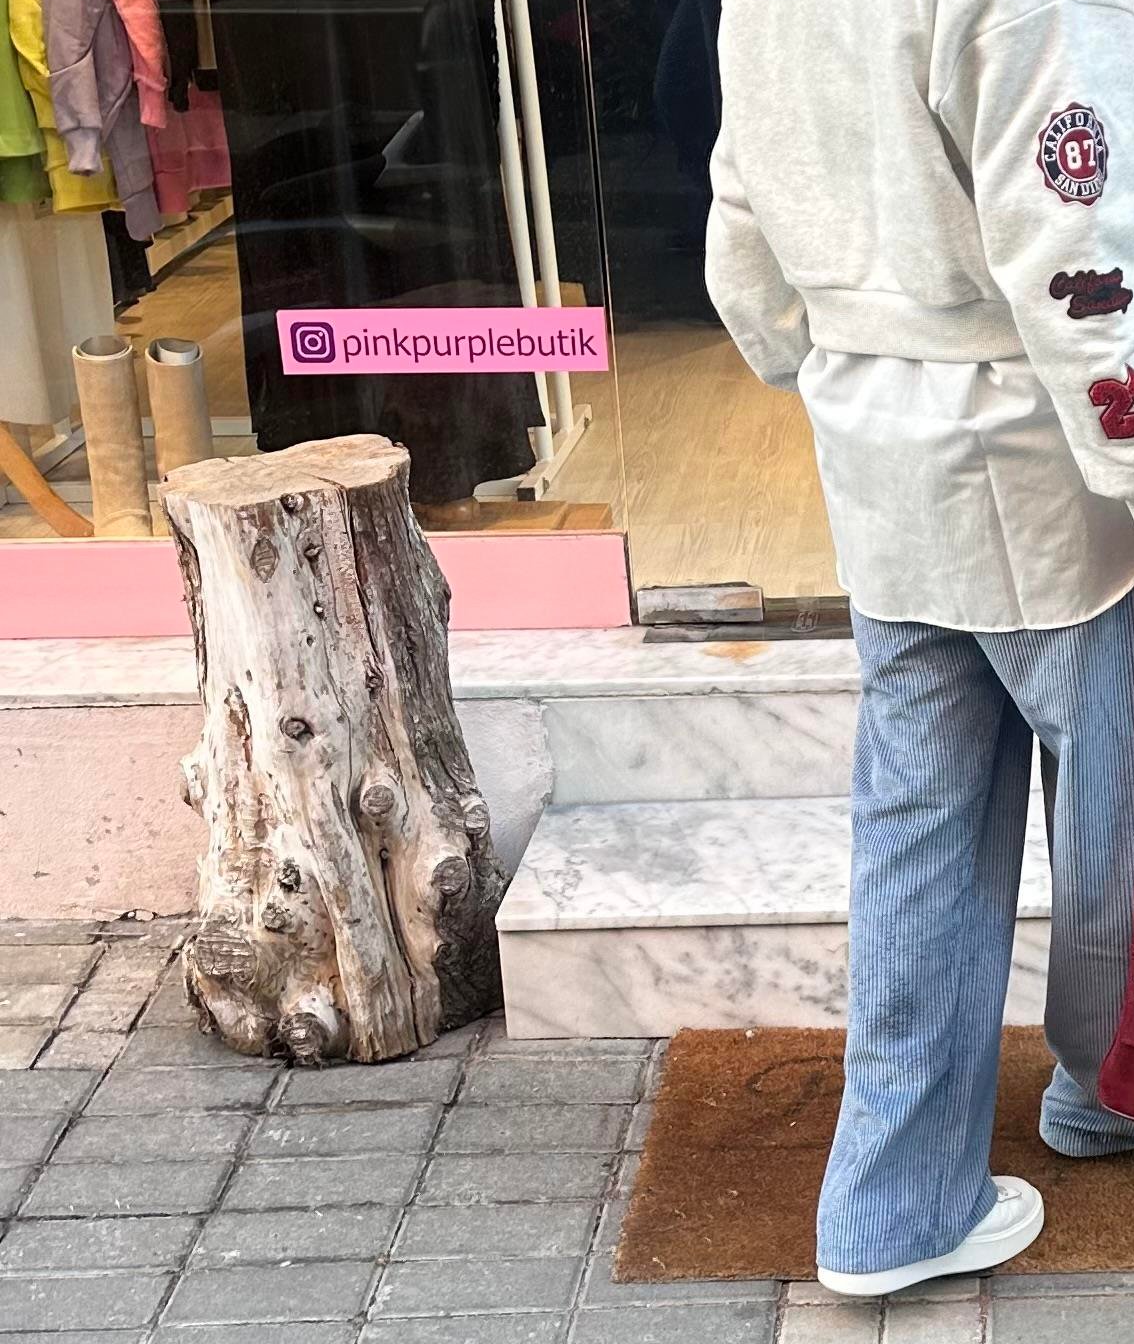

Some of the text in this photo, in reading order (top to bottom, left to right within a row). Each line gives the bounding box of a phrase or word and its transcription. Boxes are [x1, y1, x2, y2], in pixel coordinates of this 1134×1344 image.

[1064, 138, 1097, 171] 87
[1054, 173, 1080, 196] SAN
[342, 328, 598, 363] pinkpurplebutik
